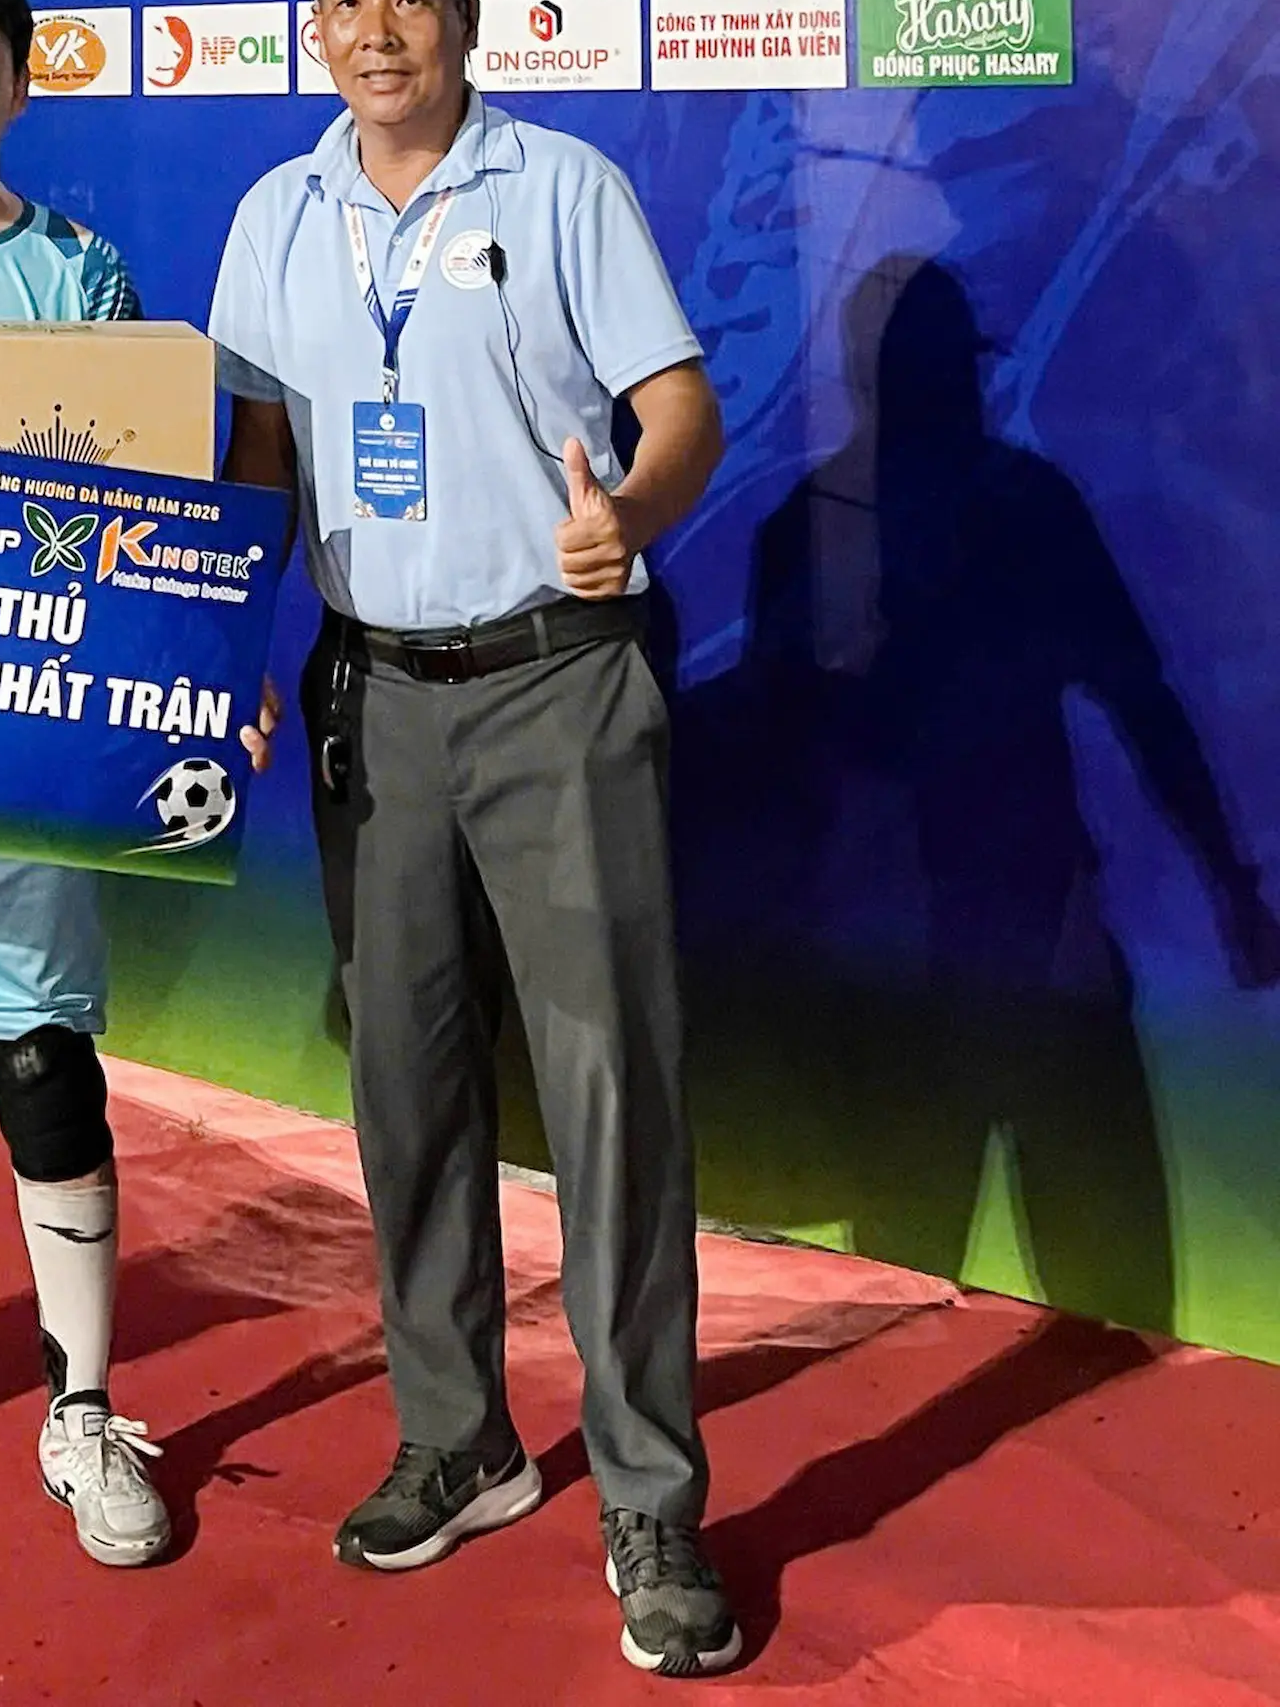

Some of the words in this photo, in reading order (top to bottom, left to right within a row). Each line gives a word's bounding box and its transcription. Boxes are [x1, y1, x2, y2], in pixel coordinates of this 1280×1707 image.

[656, 12, 695, 33] CÔNG
[700, 14, 716, 31] TY
[721, 13, 760, 31] TNHH
[765, 9, 794, 31] XÂY
[799, 11, 841, 33] DỰNG
[657, 39, 689, 60] ART
[695, 33, 756, 59] HUỲNH
[762, 37, 792, 58] GIA
[486, 50, 520, 73] DN
[524, 49, 609, 71] GROUP
[928, 53, 980, 82] PHỤC
[985, 52, 1060, 77] HASARY
[24, 479, 75, 501] HƯƠNG
[184, 502, 221, 522] 2026
[105, 675, 232, 745] TRẬN
